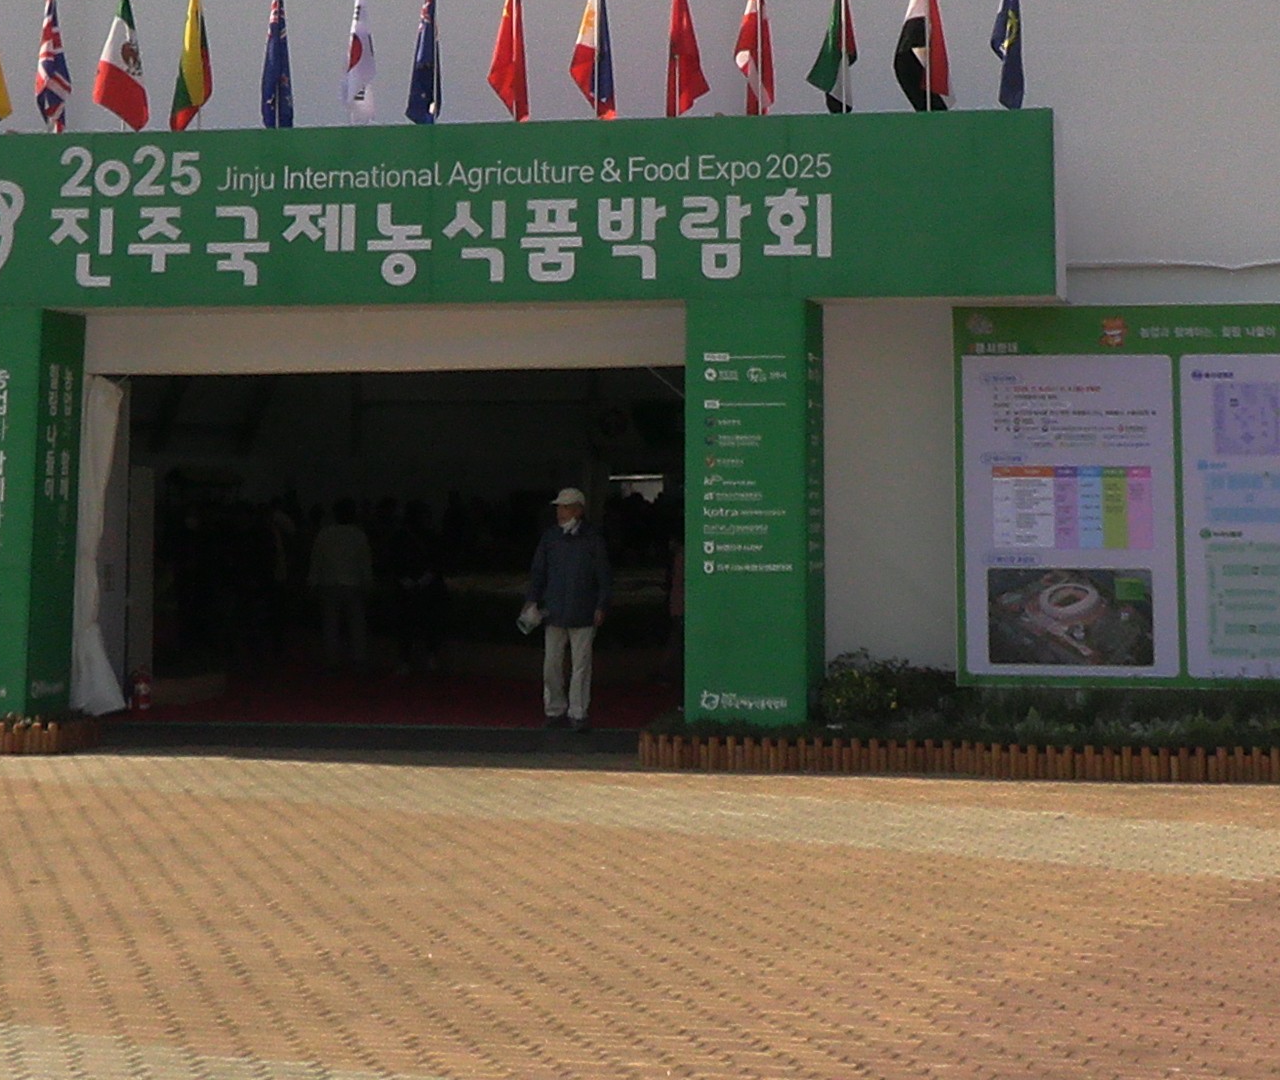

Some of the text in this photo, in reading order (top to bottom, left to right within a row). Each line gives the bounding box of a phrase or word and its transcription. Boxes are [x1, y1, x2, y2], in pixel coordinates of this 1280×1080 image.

[60, 145, 832, 198] 2025 Jinju International Agriculture & Food Expo 2025
[48, 187, 833, 287] 진주국제농식품박람회
[703, 506, 739, 518] kotra
